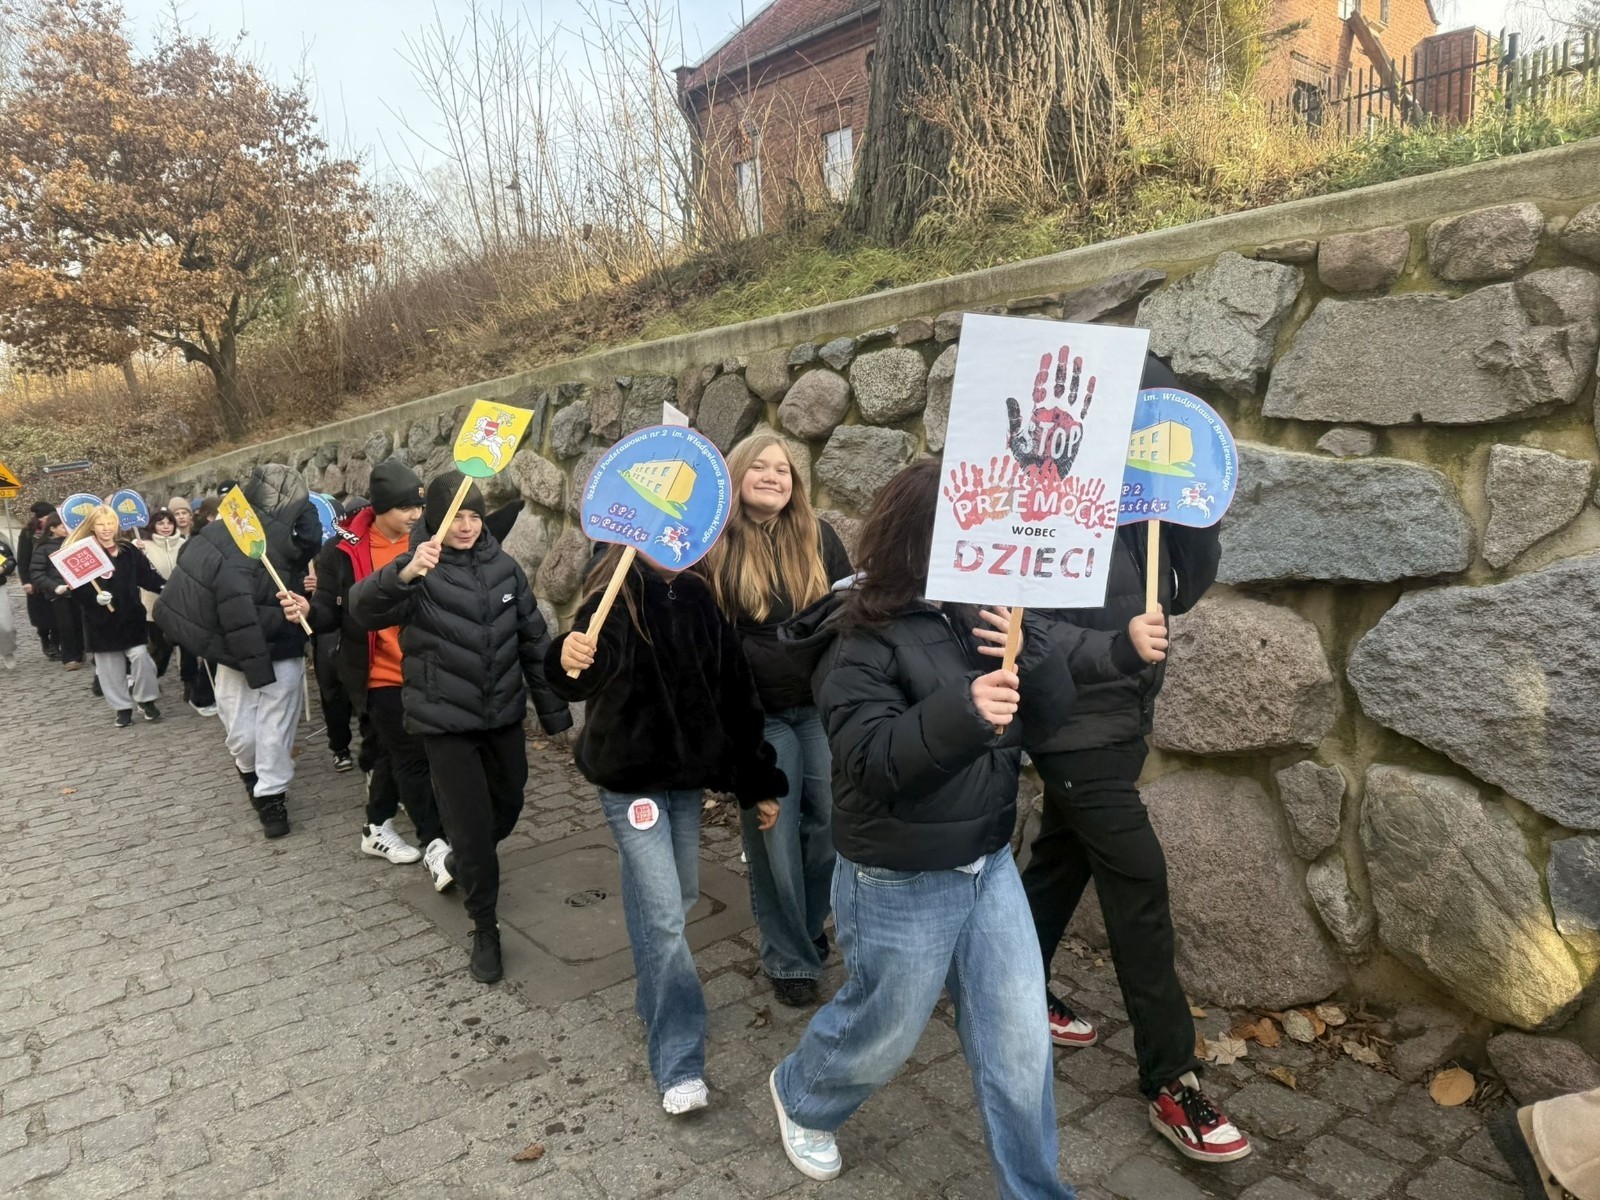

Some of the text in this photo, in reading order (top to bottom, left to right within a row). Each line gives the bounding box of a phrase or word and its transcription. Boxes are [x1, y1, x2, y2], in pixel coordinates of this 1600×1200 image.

[1020, 421, 1082, 460] STOP
[1143, 393, 1159, 402] im.
[1212, 424, 1234, 492] Broniewskiego
[600, 433, 648, 471] Podstawowa
[661, 429, 668, 437] 2
[672, 429, 684, 439] im.
[701, 479, 726, 544] Broniewskiego
[1133, 484, 1141, 495] 2
[627, 509, 635, 519] 2
[1119, 500, 1168, 514] asłęku
[590, 515, 600, 523] w
[1011, 525, 1057, 538] WOBEC
[953, 539, 1096, 579] DZIECI
